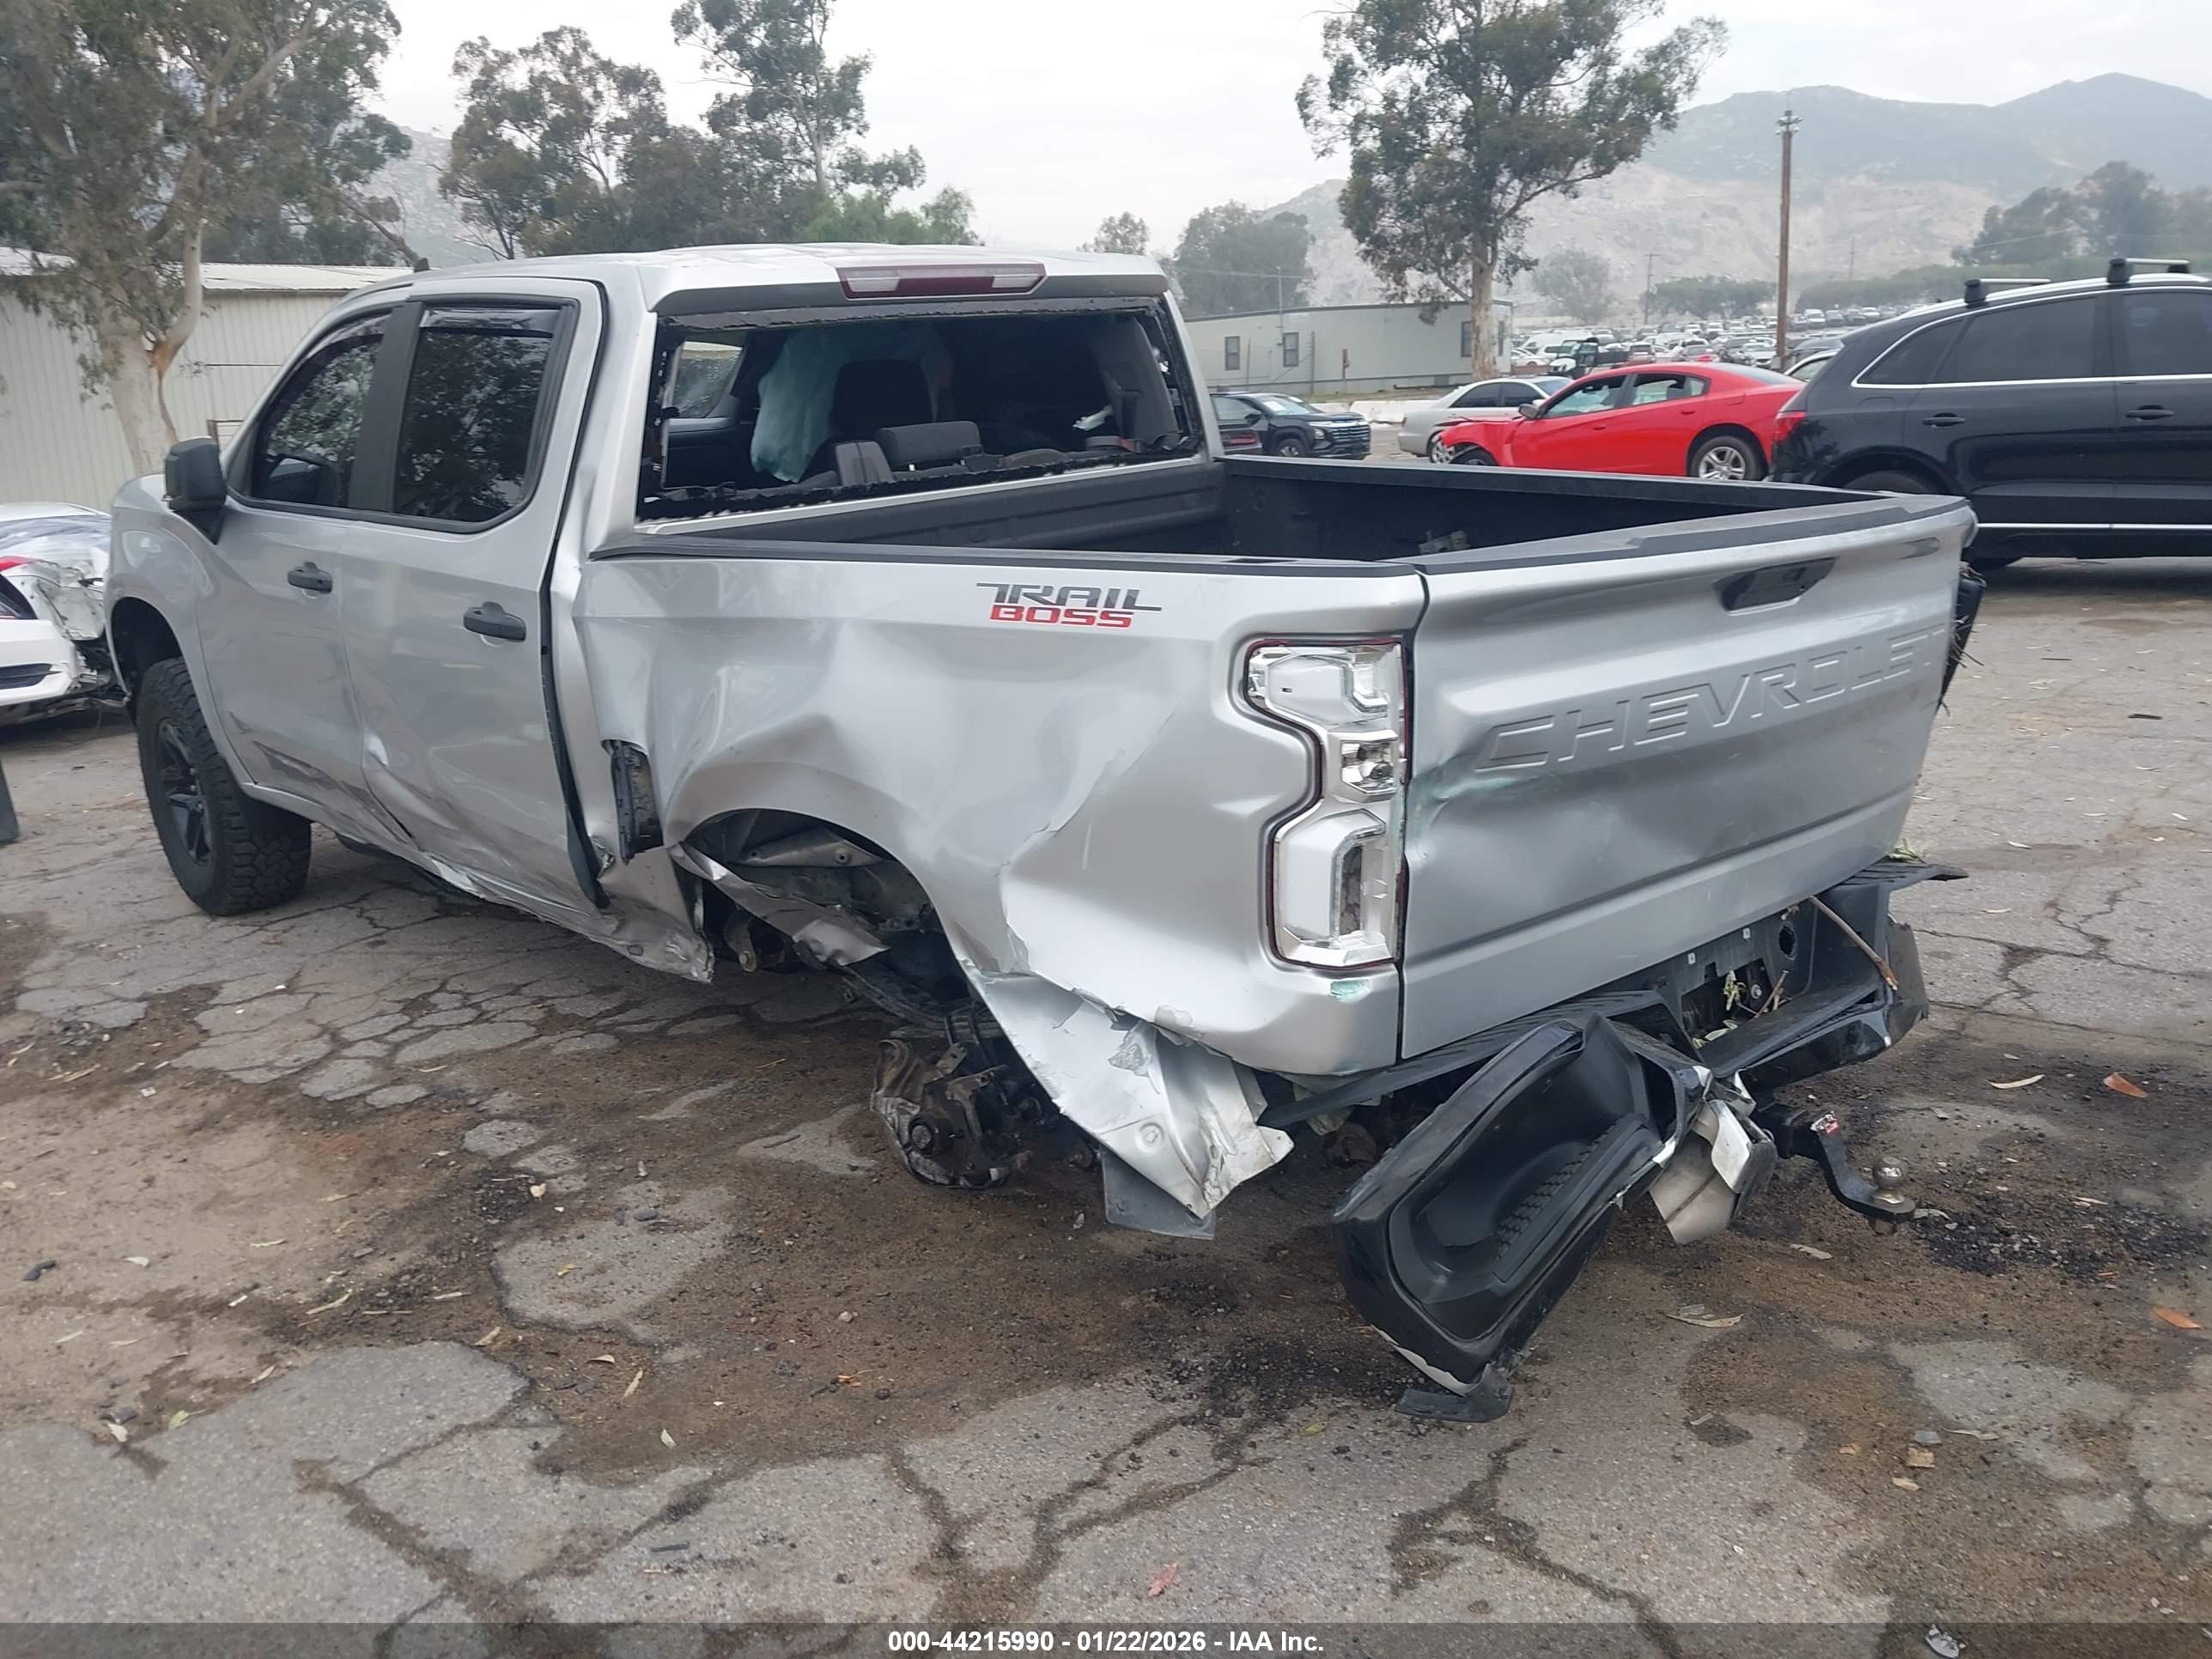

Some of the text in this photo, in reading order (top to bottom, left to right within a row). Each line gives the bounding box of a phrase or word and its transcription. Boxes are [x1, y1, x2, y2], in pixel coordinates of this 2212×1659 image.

[976, 583, 1162, 611] TRAIL
[989, 605, 1133, 629] BOSS
[1474, 623, 1945, 772] CHEVROLET
